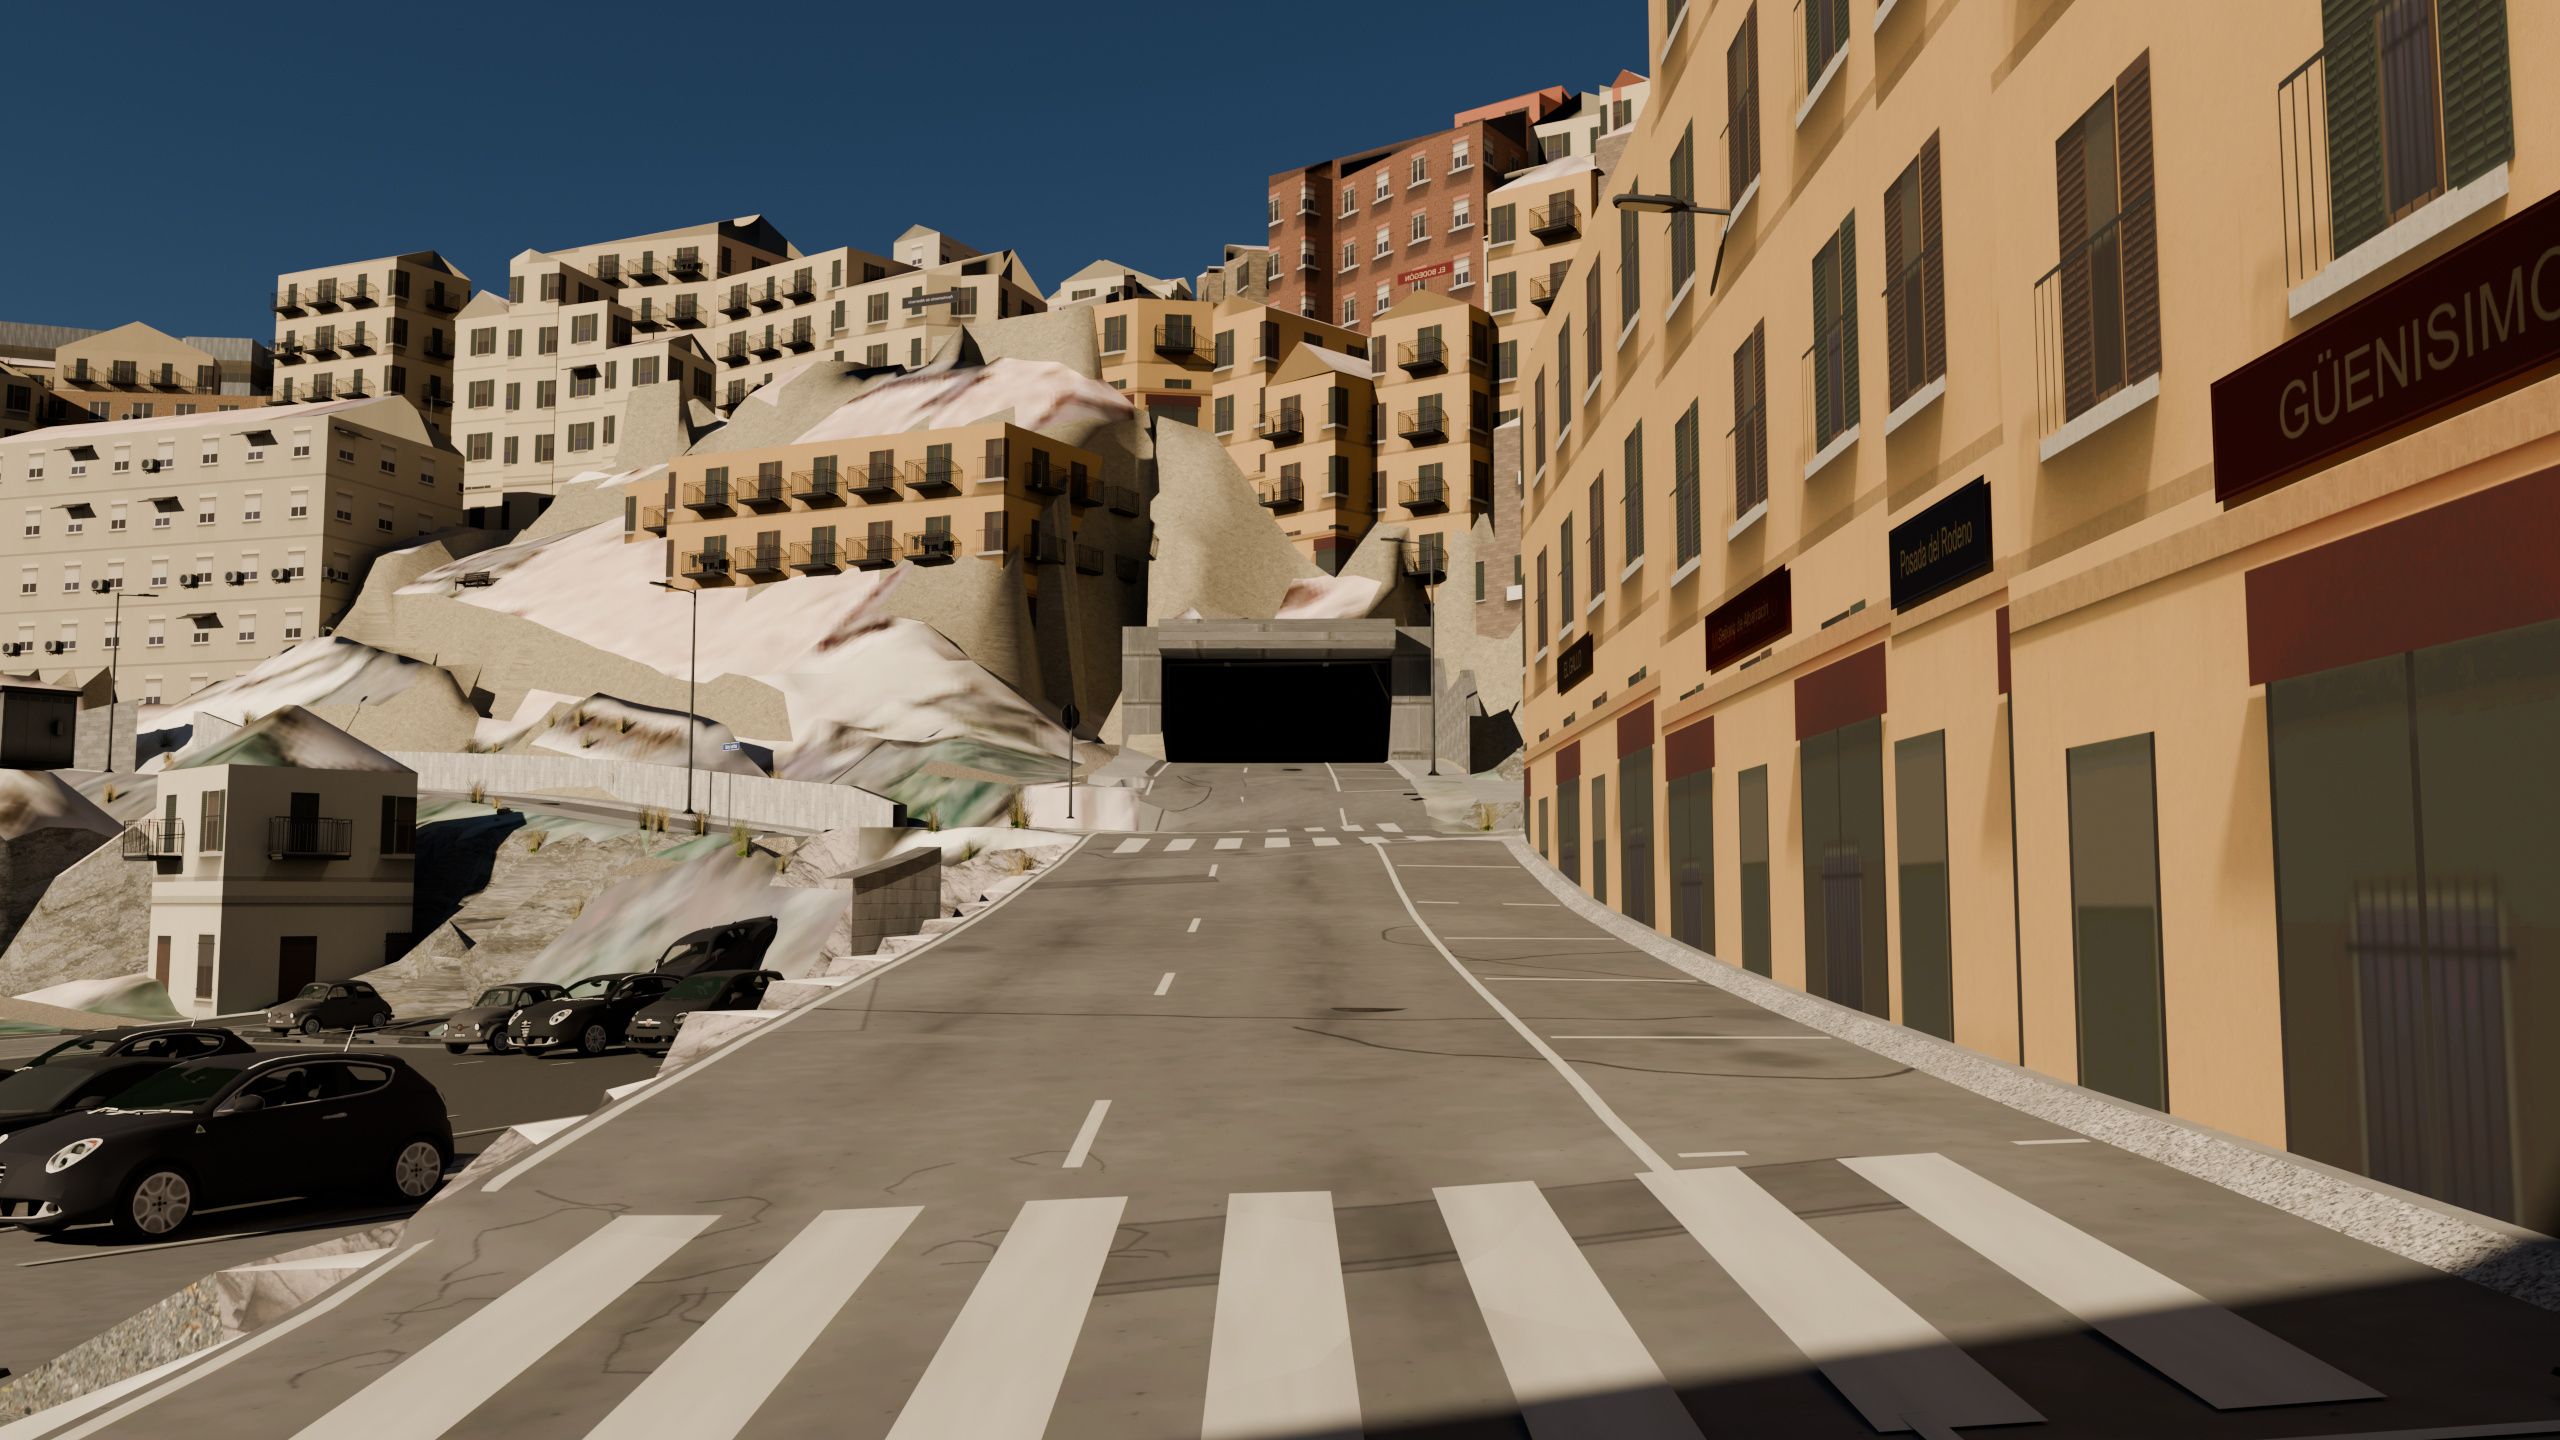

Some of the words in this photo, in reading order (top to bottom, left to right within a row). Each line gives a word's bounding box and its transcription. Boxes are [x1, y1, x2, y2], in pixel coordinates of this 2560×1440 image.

[1899, 540, 1927, 579] Posada
[1928, 529, 1940, 563] del
[1941, 520, 1973, 557] Rodeno
